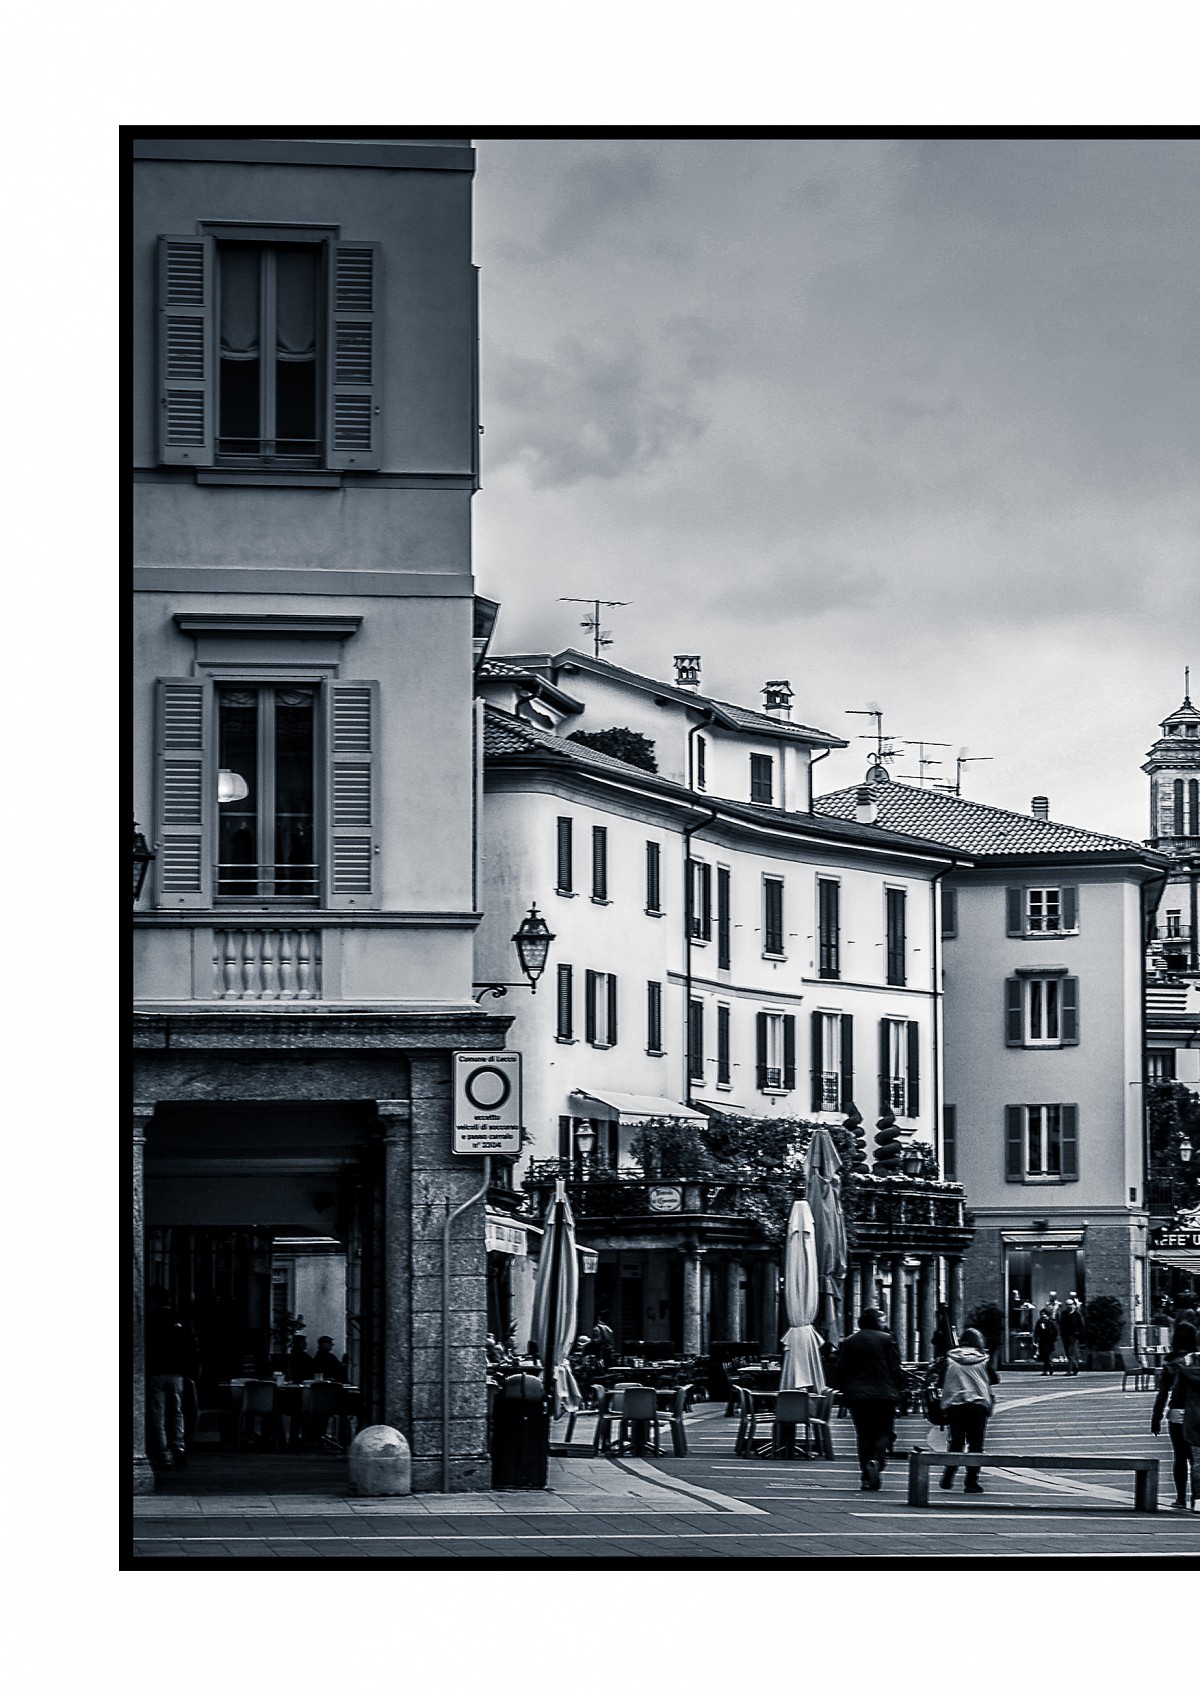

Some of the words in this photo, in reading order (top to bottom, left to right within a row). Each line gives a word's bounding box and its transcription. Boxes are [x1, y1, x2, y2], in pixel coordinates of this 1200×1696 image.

[458, 1055, 486, 1063] Comune
[487, 1055, 495, 1063] di
[496, 1055, 517, 1063] Lecco
